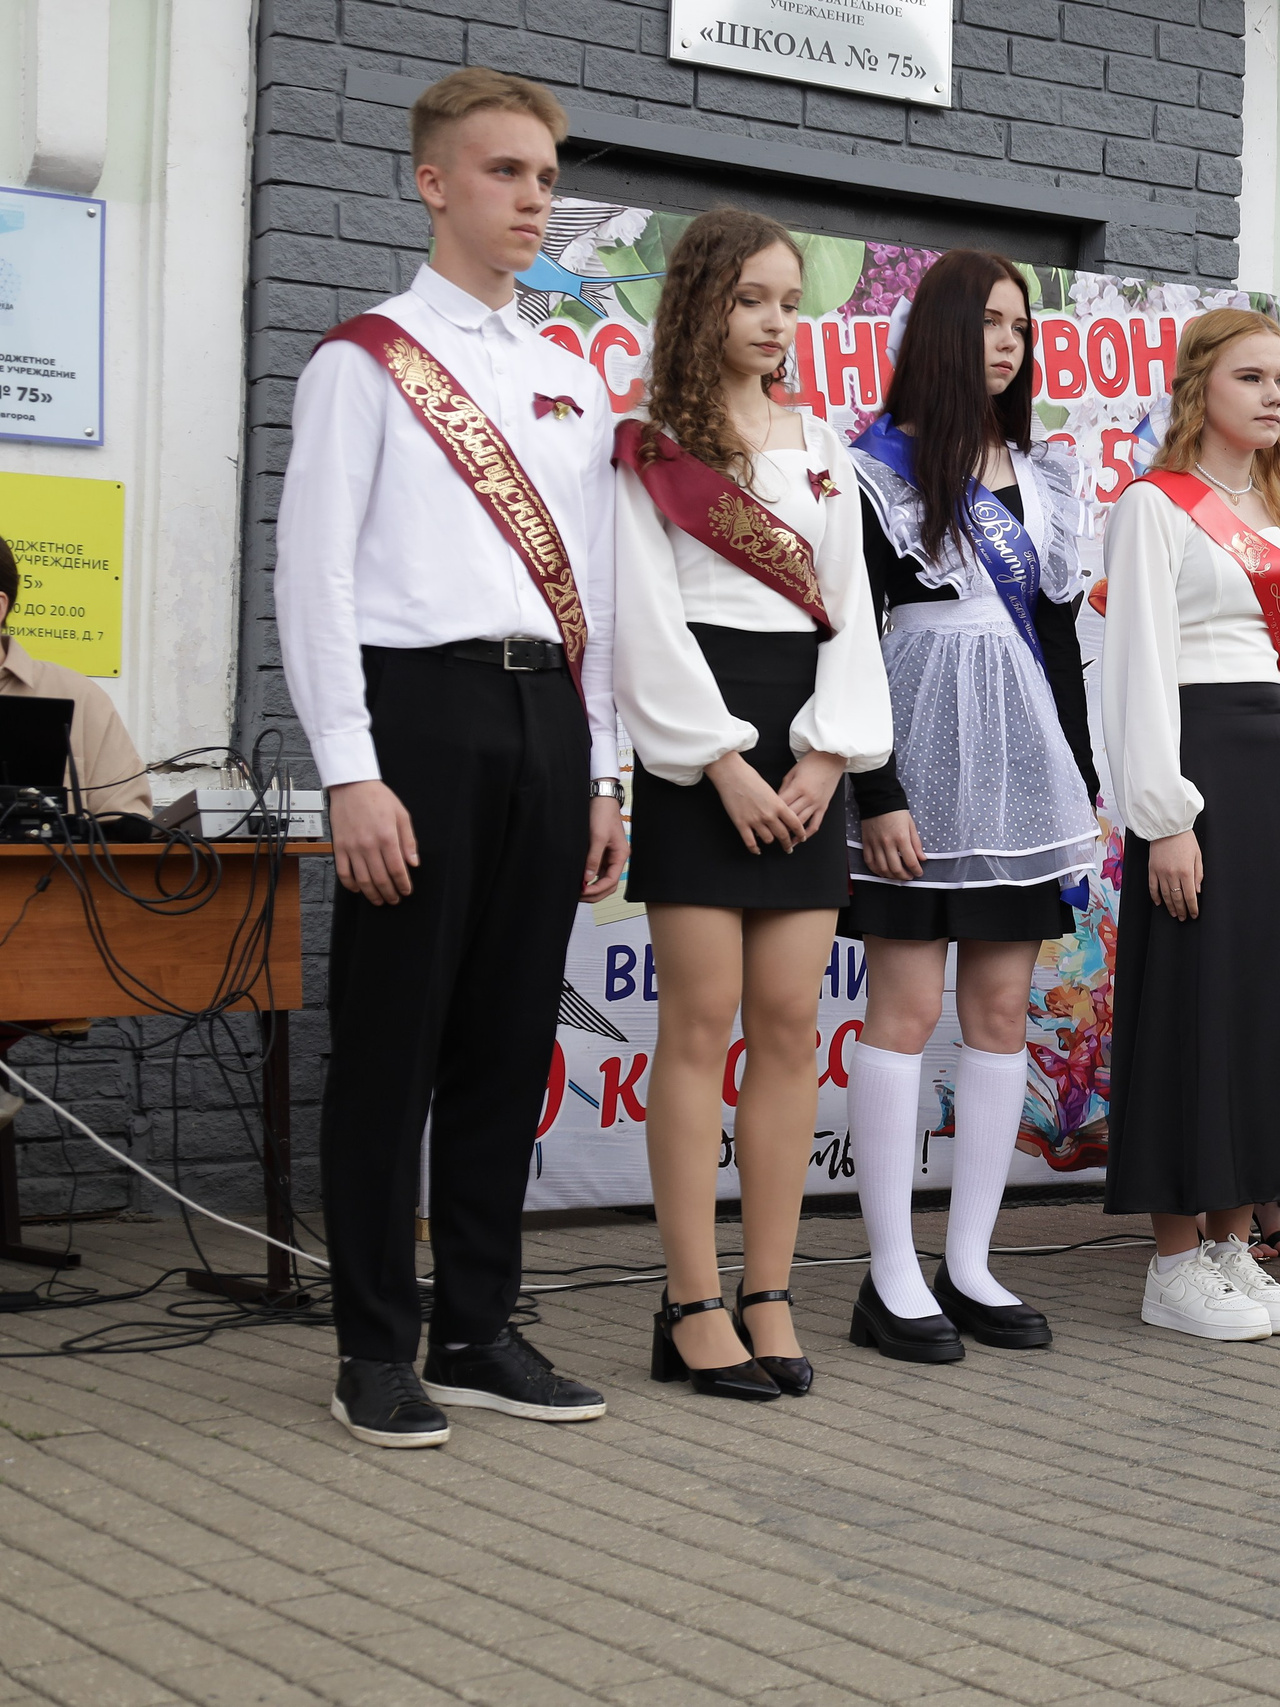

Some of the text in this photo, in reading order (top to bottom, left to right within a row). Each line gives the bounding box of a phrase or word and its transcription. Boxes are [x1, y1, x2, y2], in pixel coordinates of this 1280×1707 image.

[770, 0, 865, 26] УЧРЕЖДЕНИЕ
[699, 20, 927, 80] «ШКОЛА № 75»
[7, 365, 76, 379] УЧРЕЖДЕНИЕ
[17, 386, 53, 403] 75»
[0, 412, 36, 421] вгород
[426, 393, 588, 663] Выпускник 2025
[15, 553, 110, 571] УЧРЕЖДЕНИЕ
[24, 603, 46, 617] ДО
[50, 604, 86, 618] 20.00
[82, 630, 94, 642] Д.
[97, 631, 104, 640] 7
